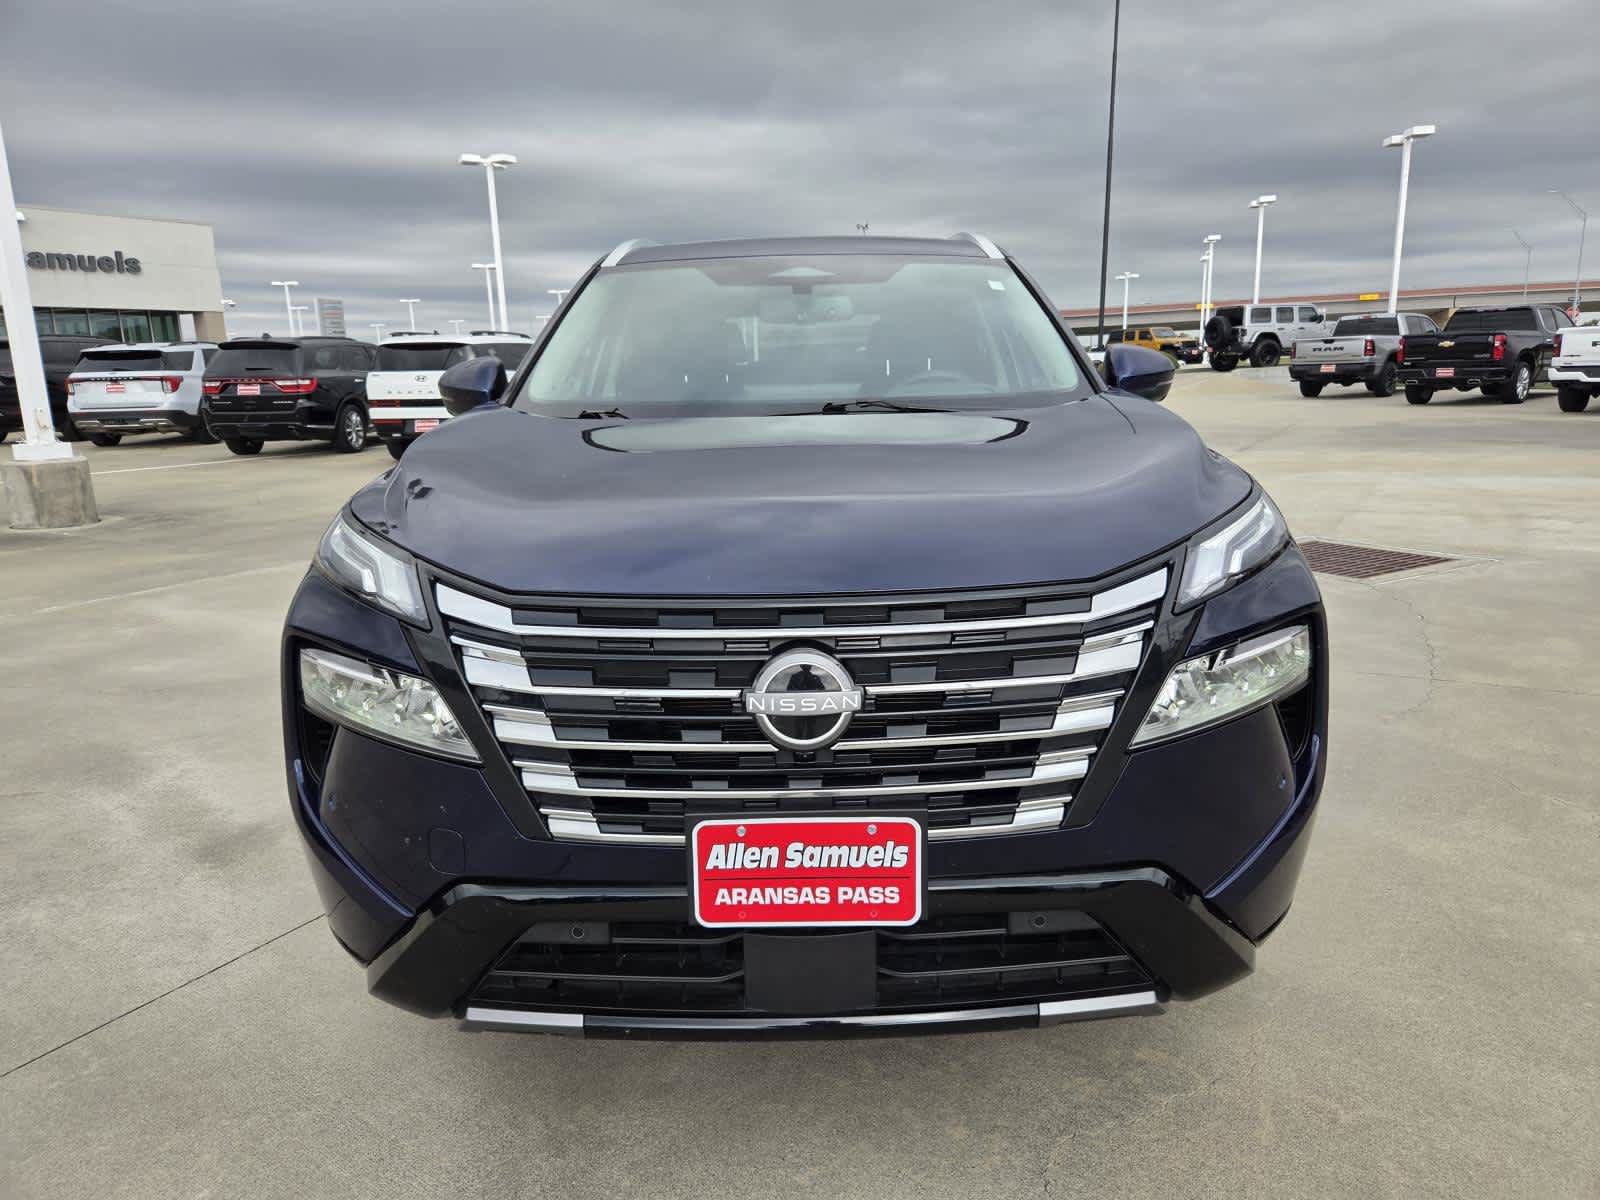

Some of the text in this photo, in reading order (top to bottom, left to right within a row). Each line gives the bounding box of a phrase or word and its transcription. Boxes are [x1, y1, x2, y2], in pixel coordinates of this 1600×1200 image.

[26, 250, 142, 274] amuels
[748, 696, 860, 713] NISSAN
[705, 841, 909, 870] Allen Samuels
[714, 887, 900, 905] ARANSAS PASS
